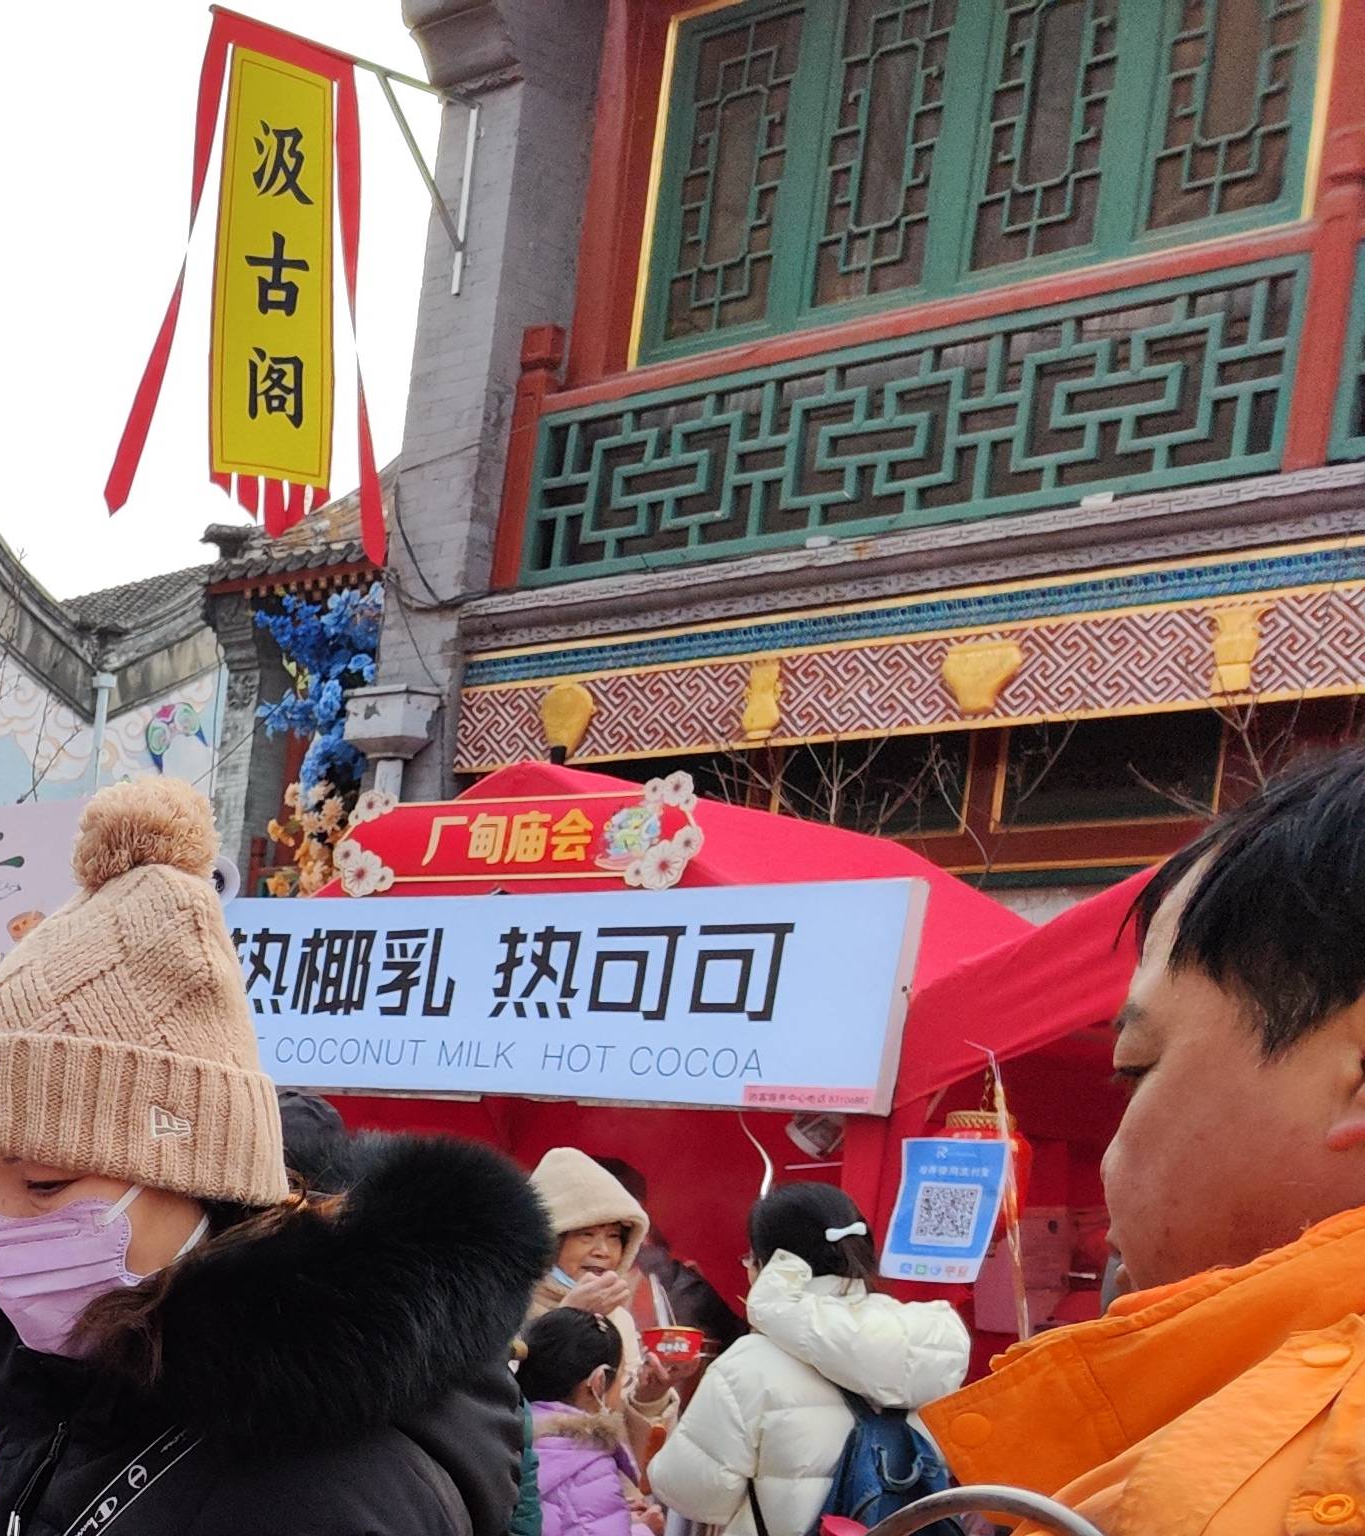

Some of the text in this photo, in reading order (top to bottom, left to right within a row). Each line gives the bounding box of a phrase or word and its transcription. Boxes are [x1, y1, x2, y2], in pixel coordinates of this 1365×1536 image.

[244, 119, 314, 430] 汲古阁
[421, 807, 594, 867] 厂甸庙会
[230, 921, 796, 1022] 热椰乳 热可可
[275, 1037, 764, 1079] COCONUT MILK HOT COCOA
